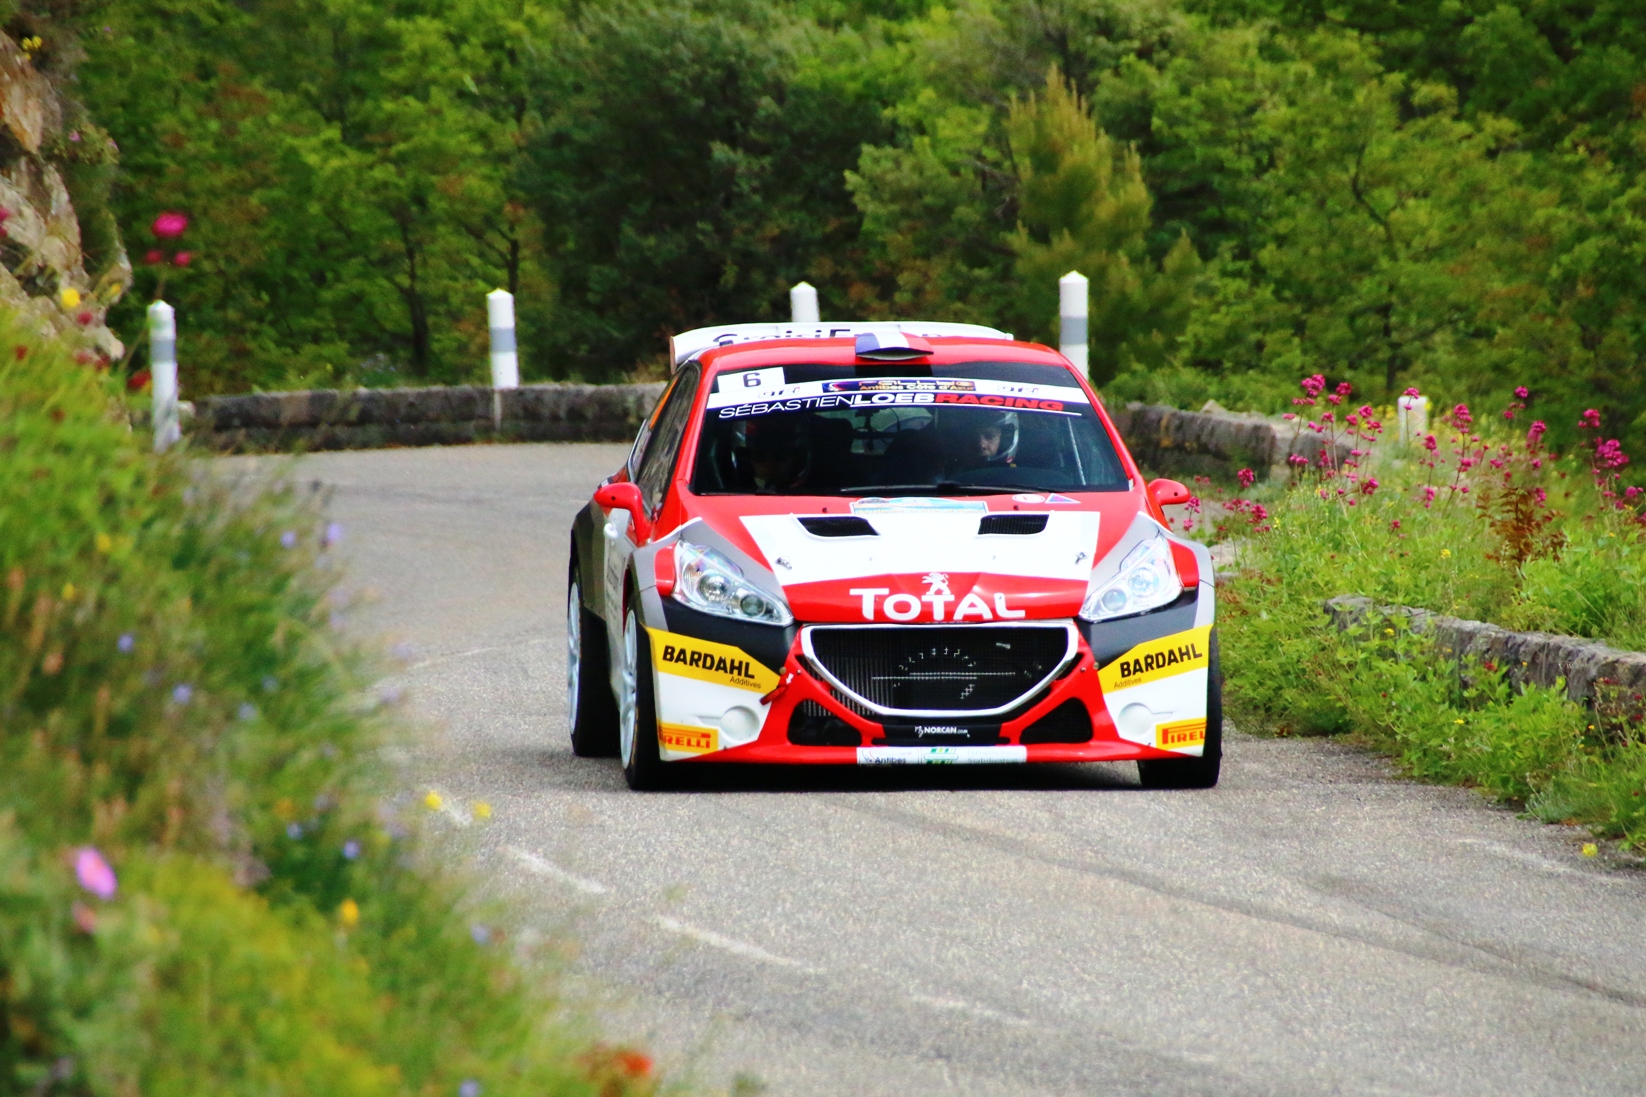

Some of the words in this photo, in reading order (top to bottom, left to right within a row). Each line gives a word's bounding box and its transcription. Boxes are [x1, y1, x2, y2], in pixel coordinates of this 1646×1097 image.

[743, 372, 761, 388] 6
[850, 588, 1026, 621] TOTAL
[662, 645, 755, 679] BARDAHL
[1119, 643, 1203, 678] BARDAHL
[730, 676, 761, 689] Additives
[1113, 677, 1142, 689] Additives
